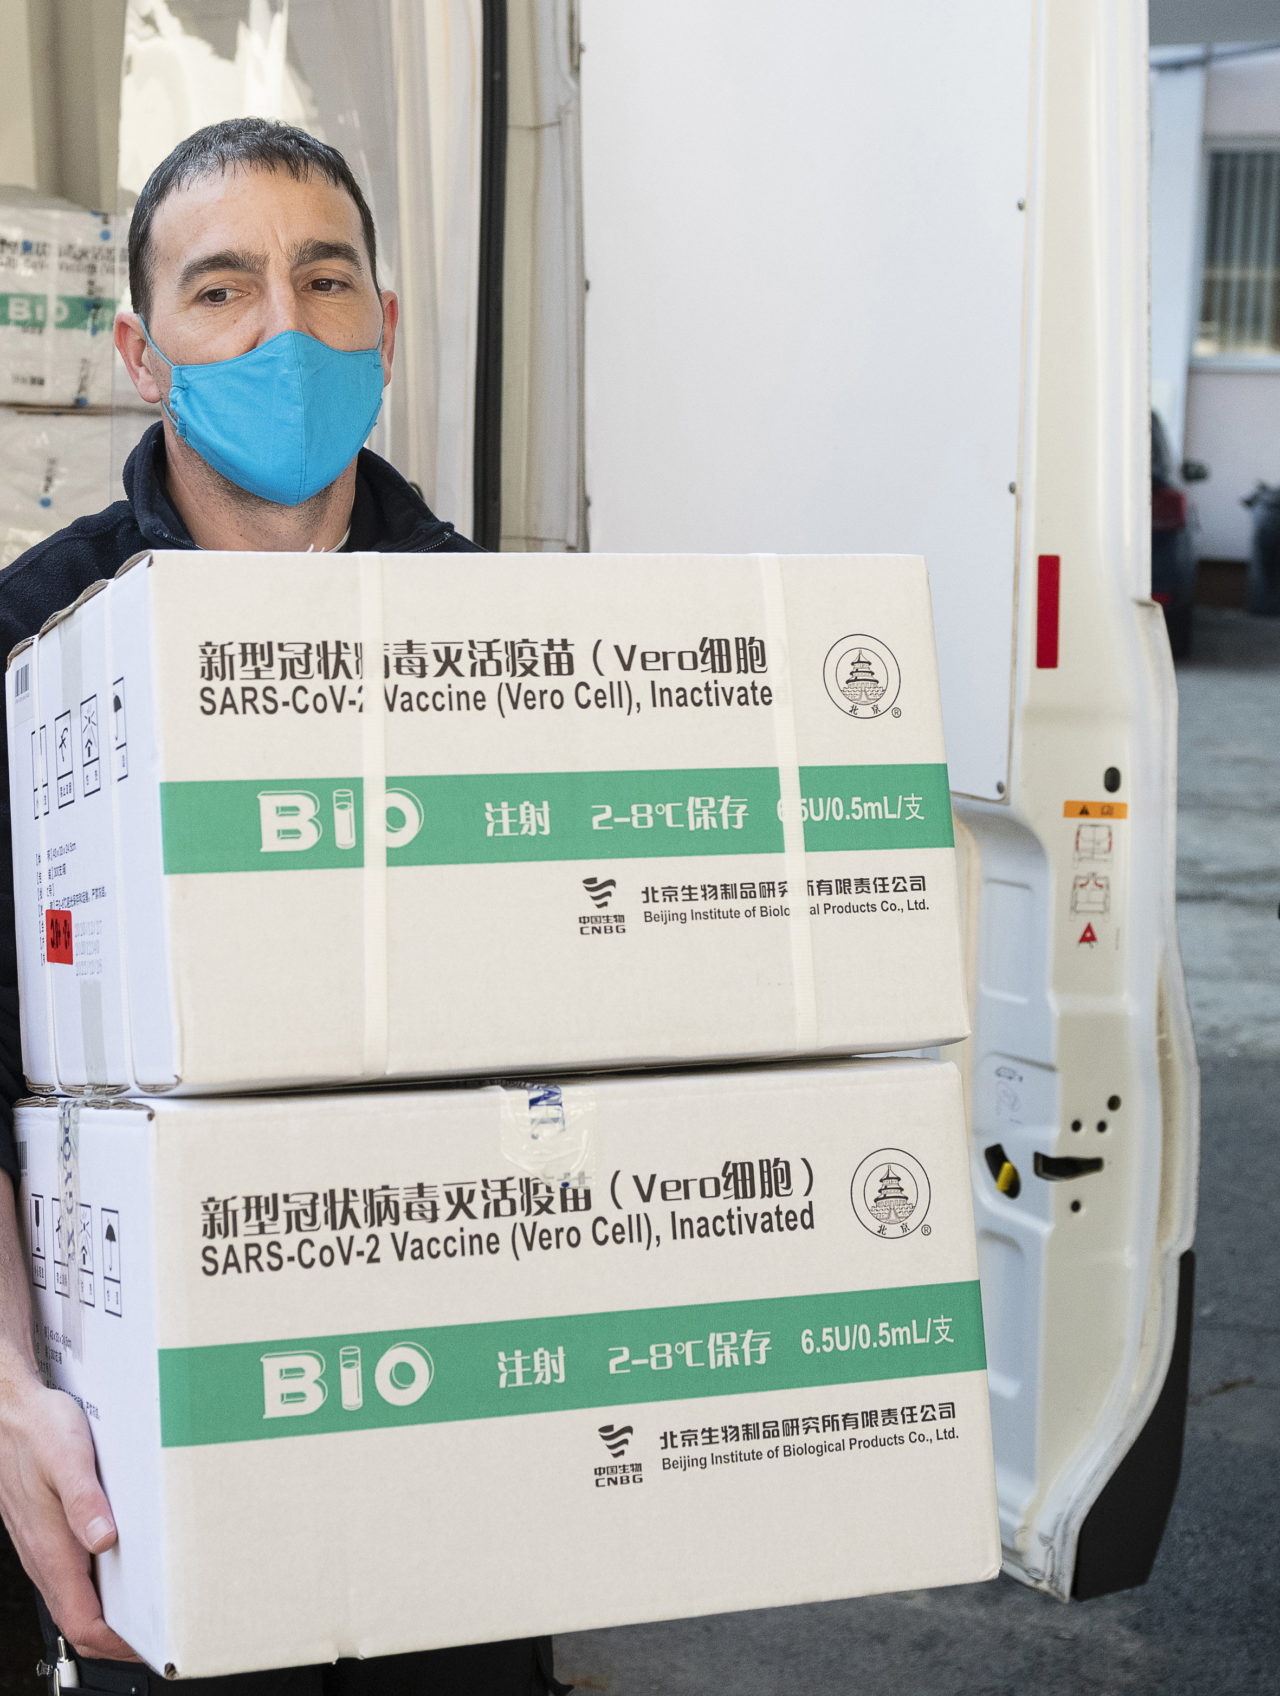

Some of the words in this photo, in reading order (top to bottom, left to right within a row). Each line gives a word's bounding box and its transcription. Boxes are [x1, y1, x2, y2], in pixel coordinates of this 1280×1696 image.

[384, 683, 488, 713] Vaccine
[497, 681, 565, 718] (Vero
[574, 680, 641, 716] Cell),
[650, 679, 774, 708] Inactivate
[483, 800, 552, 837] 注射
[776, 792, 926, 823] 5U/0.5mL/支
[578, 914, 625, 925] 中国生物
[579, 925, 626, 936] CNBG
[643, 910, 687, 925] Beijing
[690, 907, 741, 921] Institute
[744, 906, 757, 919] of
[823, 901, 878, 915] Products
[880, 900, 904, 913] Co.,
[907, 899, 930, 911] Ltd.
[201, 1233, 381, 1276] SARS-CoV-2
[390, 1227, 501, 1261] Vaccine
[511, 1221, 581, 1261] (Vero
[592, 1213, 661, 1251] Cell),
[670, 1201, 815, 1240] Inactivated
[497, 1346, 566, 1388] 注射
[801, 1314, 955, 1354] 6.5U/0.5mL/支
[659, 1402, 956, 1450] 北京生物制品研究所有限责任公司
[662, 1454, 708, 1472] Beijing
[710, 1448, 763, 1466] Institute
[767, 1446, 781, 1460] of
[783, 1438, 846, 1458] Biological
[849, 1432, 905, 1450] Products
[908, 1431, 933, 1445] Co.,
[936, 1427, 960, 1441] Ltd.
[594, 1463, 642, 1477] 中国生物
[595, 1474, 643, 1488] CNBG
